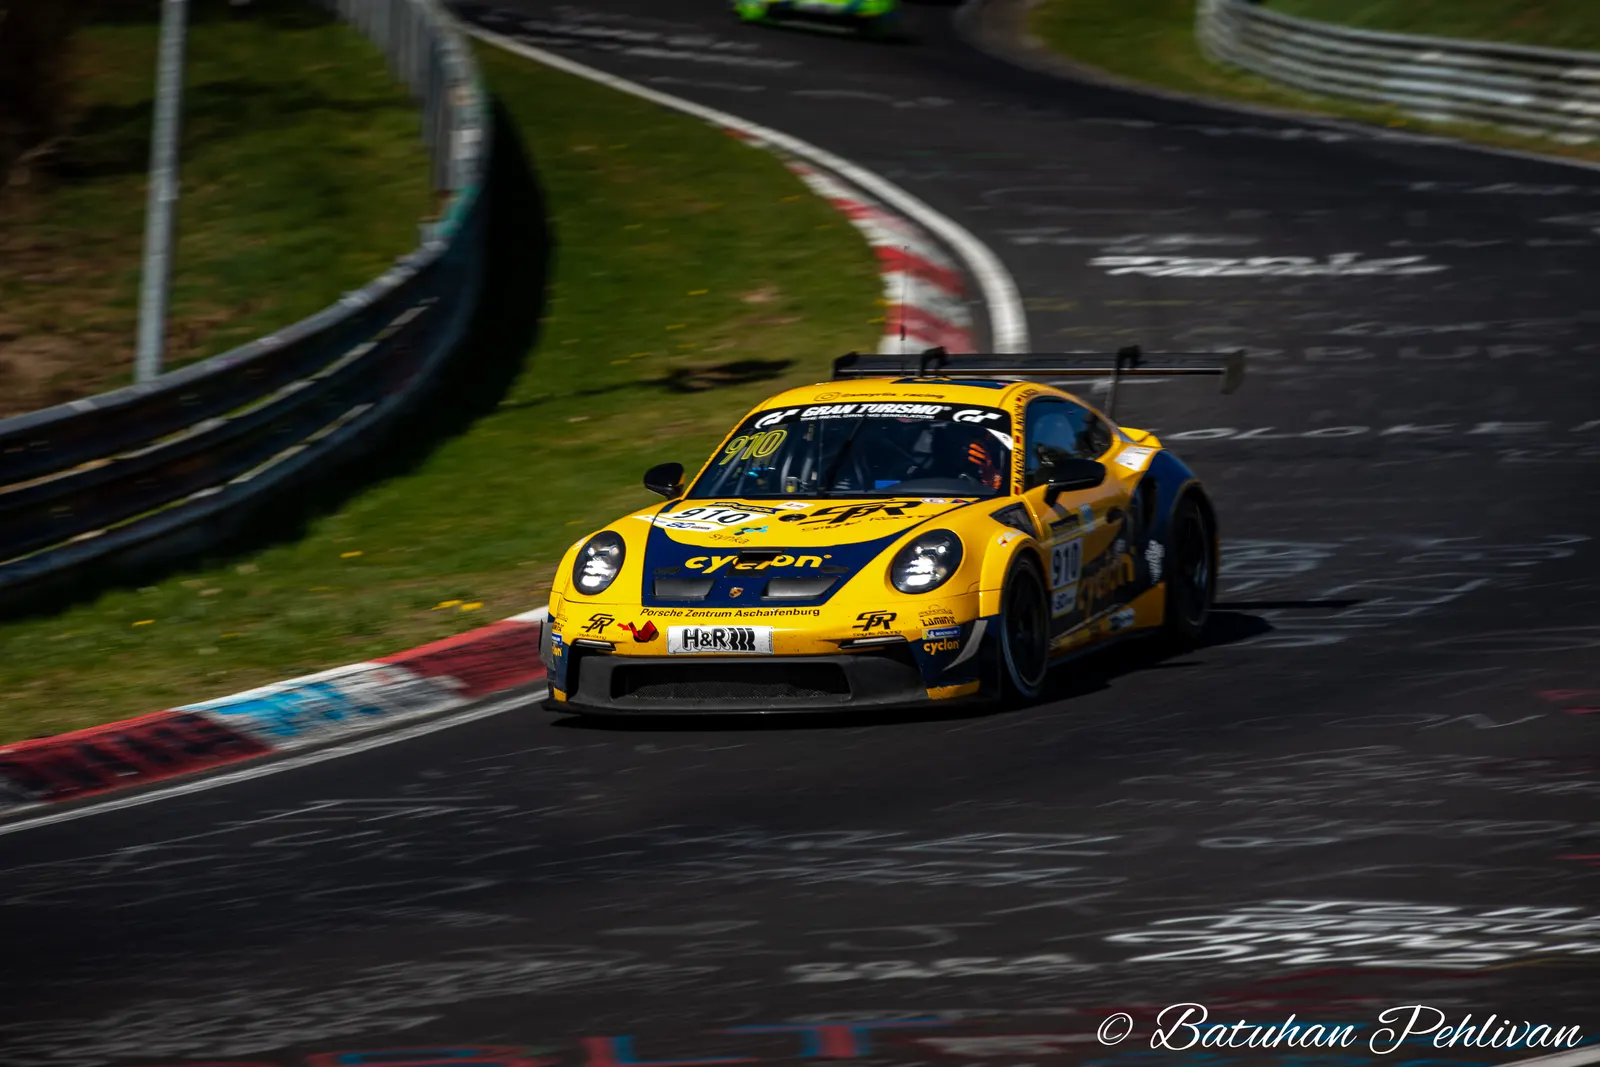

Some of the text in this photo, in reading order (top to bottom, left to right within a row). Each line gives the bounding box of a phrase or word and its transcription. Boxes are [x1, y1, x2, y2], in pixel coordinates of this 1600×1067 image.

[800, 403, 859, 418] GRAN
[719, 429, 788, 466] 910
[672, 508, 751, 524] 910
[1053, 542, 1080, 586] 910
[640, 608, 684, 618] Porsche
[684, 609, 732, 618] Zentrum
[682, 627, 731, 650] H&R
[923, 638, 959, 656] cyclon
